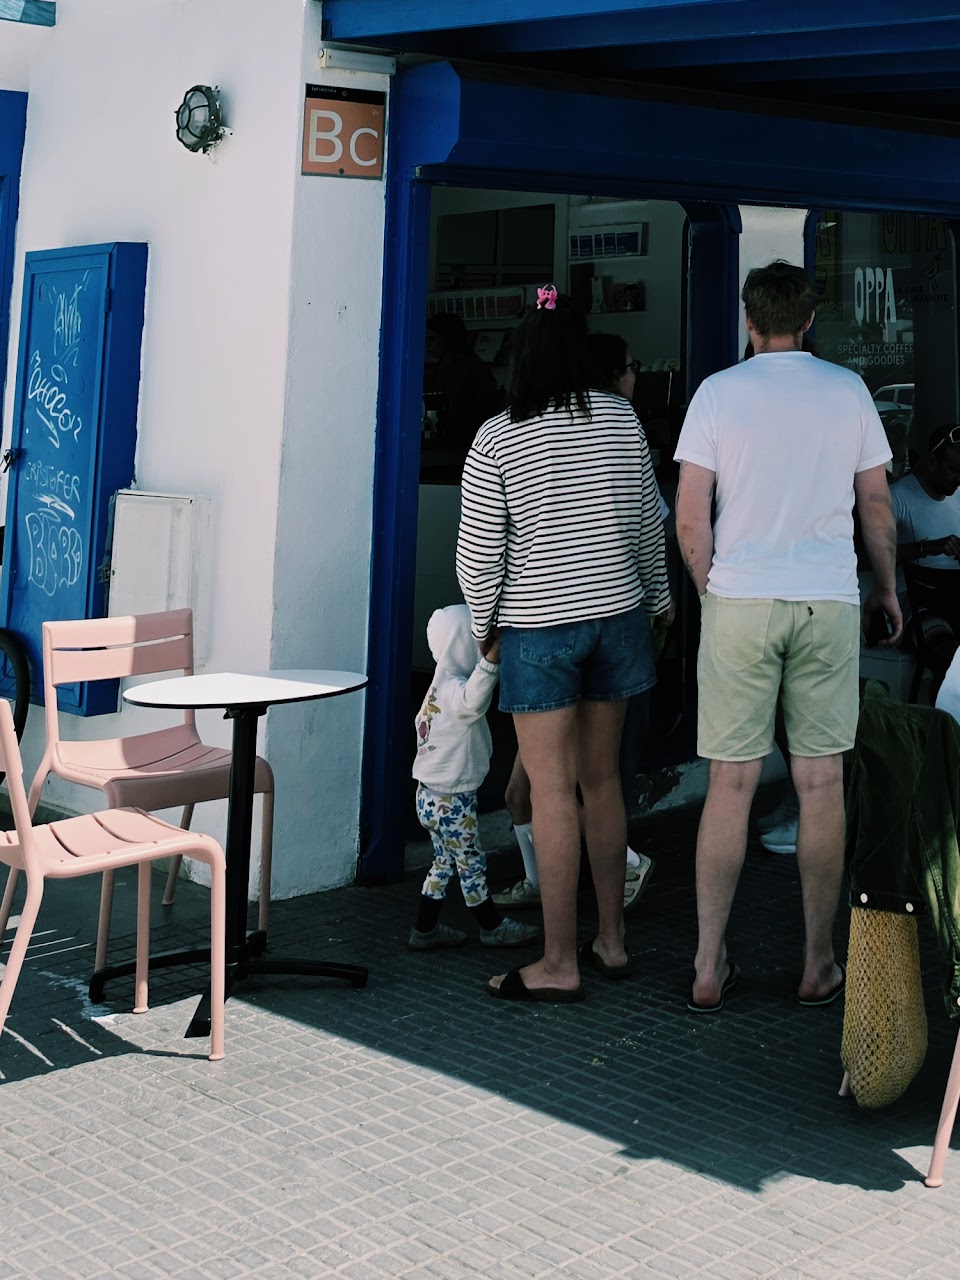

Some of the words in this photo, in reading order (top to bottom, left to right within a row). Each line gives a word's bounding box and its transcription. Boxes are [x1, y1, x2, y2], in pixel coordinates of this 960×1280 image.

[854, 266, 897, 324] OPPA
[837, 344, 881, 355] SPECIALTY
[883, 343, 913, 354] COFFEE
[848, 356, 865, 366] AND
[867, 355, 905, 365] GOODIES
